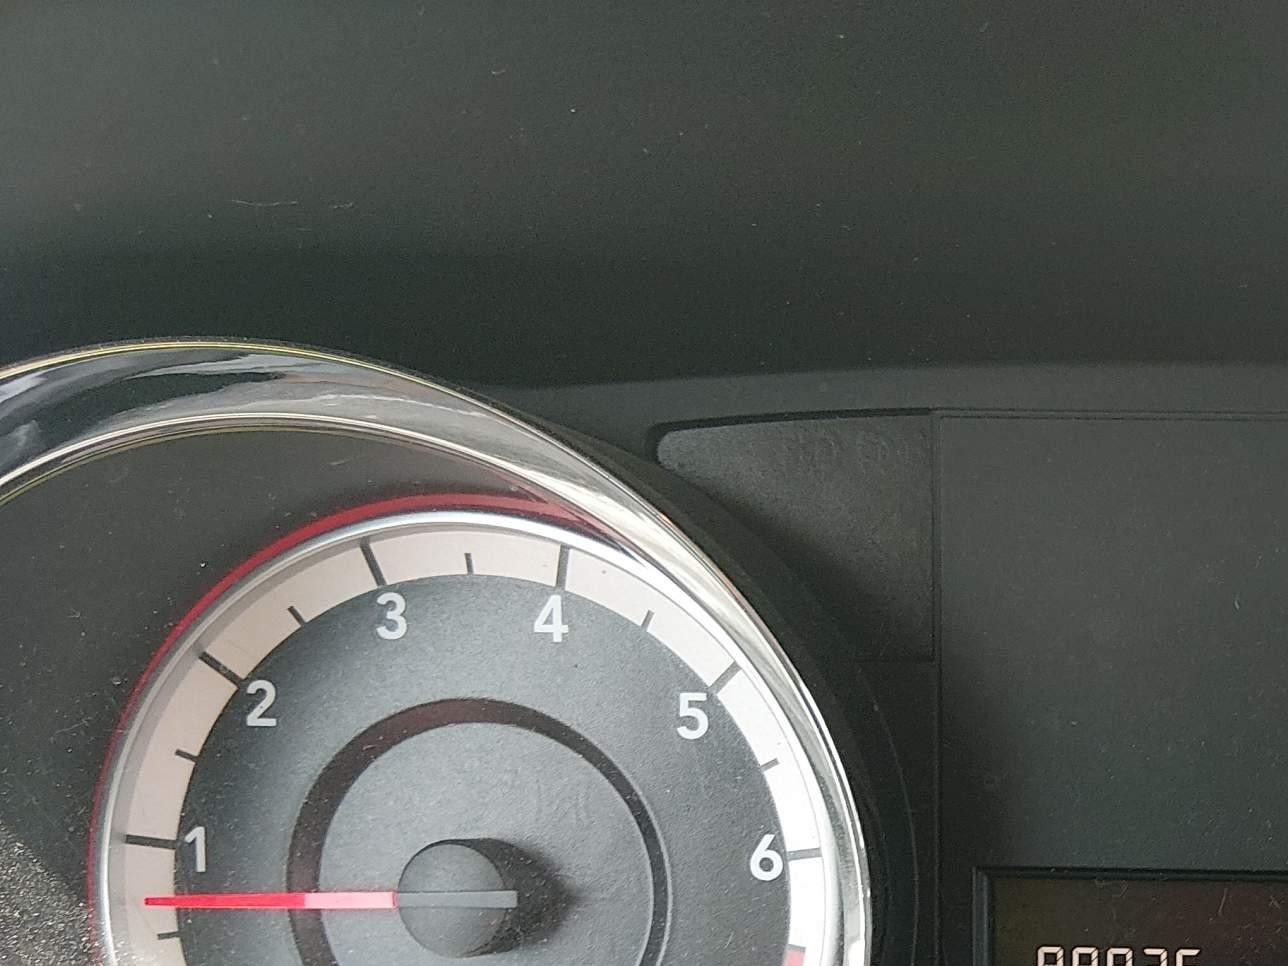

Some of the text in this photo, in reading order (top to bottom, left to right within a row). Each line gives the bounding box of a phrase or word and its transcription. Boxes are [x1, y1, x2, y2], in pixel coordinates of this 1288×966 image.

[376, 592, 408, 640] 3
[533, 594, 569, 643] 4
[245, 680, 277, 727] 2
[677, 692, 709, 740] 5
[184, 827, 206, 873] 1
[750, 835, 783, 882] 6
